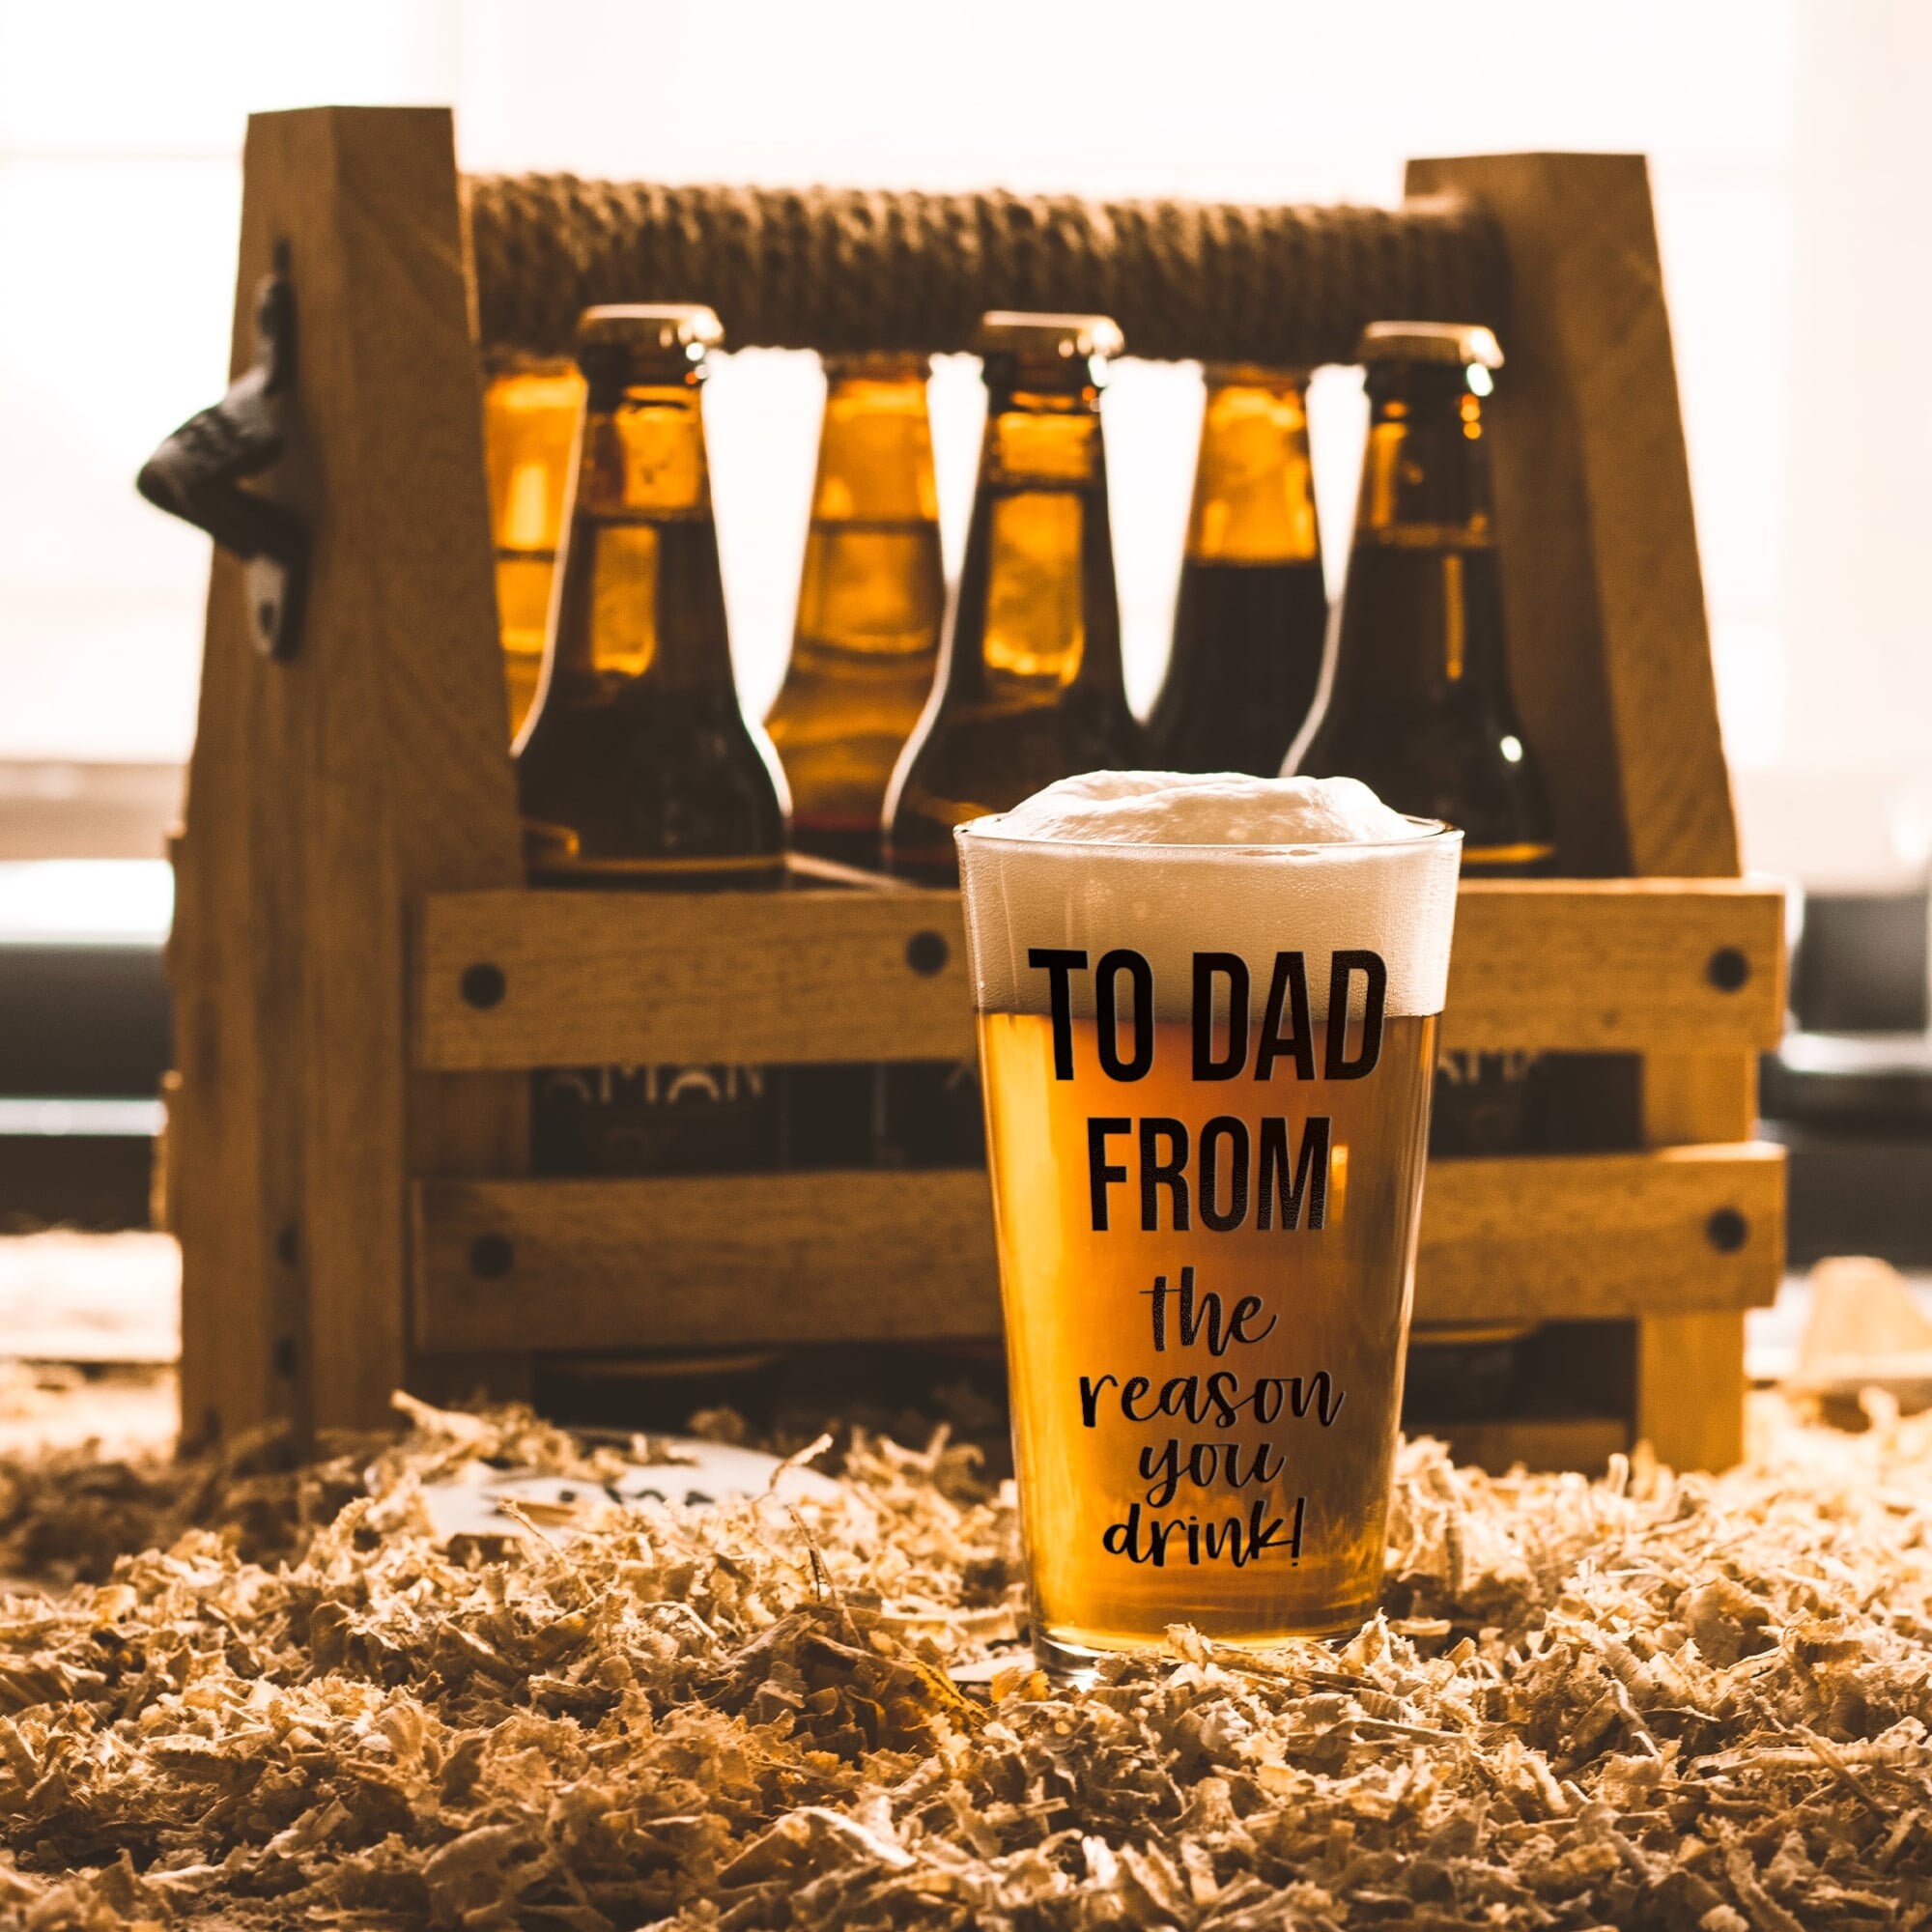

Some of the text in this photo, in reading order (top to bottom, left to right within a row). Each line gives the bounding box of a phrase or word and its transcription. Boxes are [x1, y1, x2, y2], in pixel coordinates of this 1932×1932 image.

[1028, 948, 1387, 1083] TO DAD
[1086, 1115, 1332, 1232] FROM
[1139, 1266, 1277, 1356] the
[1078, 1370, 1346, 1429] reason
[1138, 1441, 1284, 1507] you
[1102, 1498, 1306, 1569] drink!
